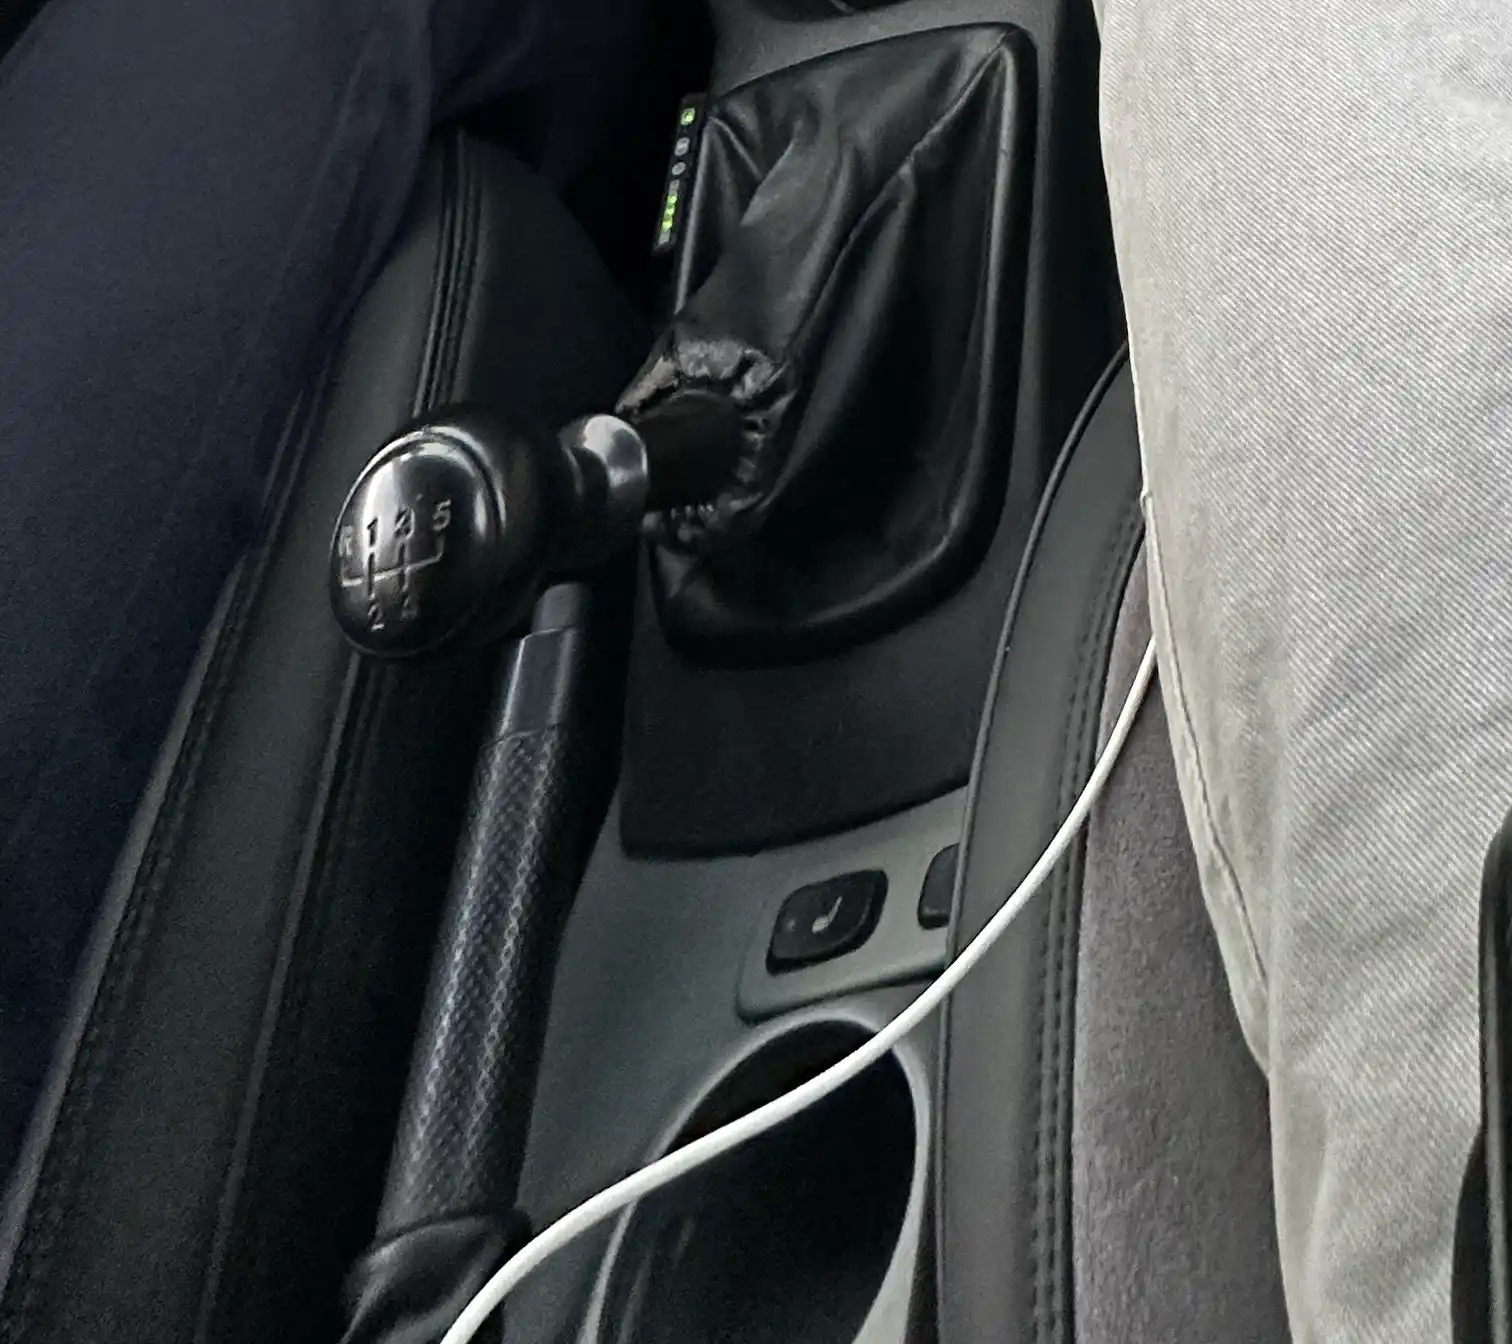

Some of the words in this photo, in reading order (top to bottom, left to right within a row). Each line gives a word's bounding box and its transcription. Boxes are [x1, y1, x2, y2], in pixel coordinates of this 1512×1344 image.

[431, 498, 453, 532] 5
[366, 517, 380, 548] 1
[366, 600, 385, 632] 2
